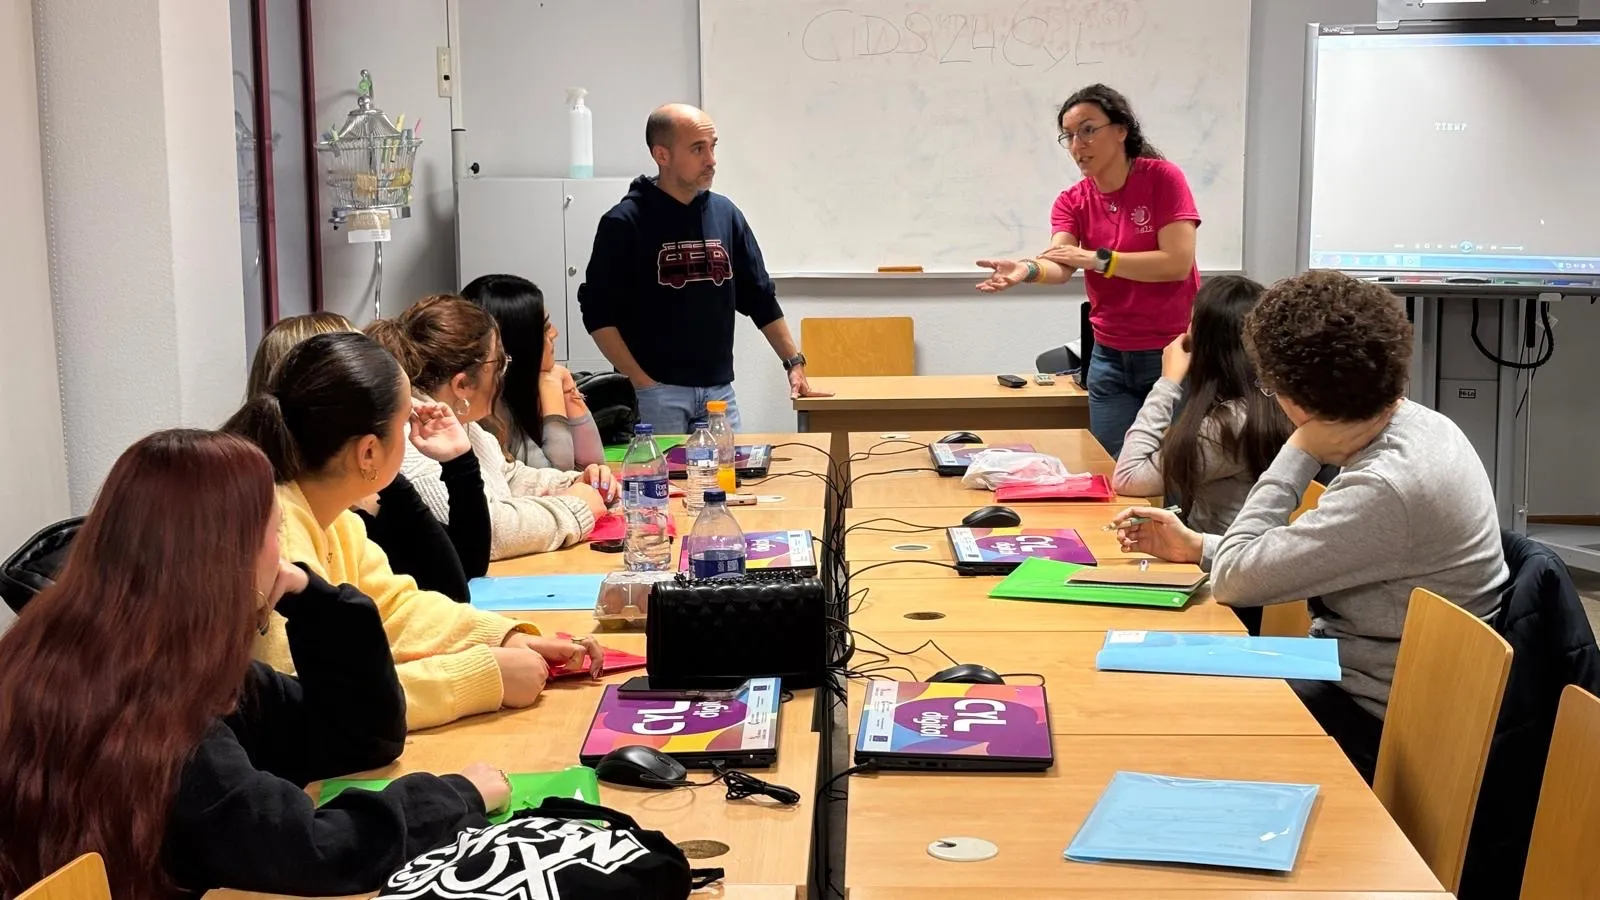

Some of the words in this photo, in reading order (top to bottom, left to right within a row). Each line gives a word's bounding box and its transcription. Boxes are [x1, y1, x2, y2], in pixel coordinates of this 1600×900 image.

[632, 700, 691, 735] CYL
[912, 711, 949, 737] digital
[953, 698, 1007, 732] CYL
